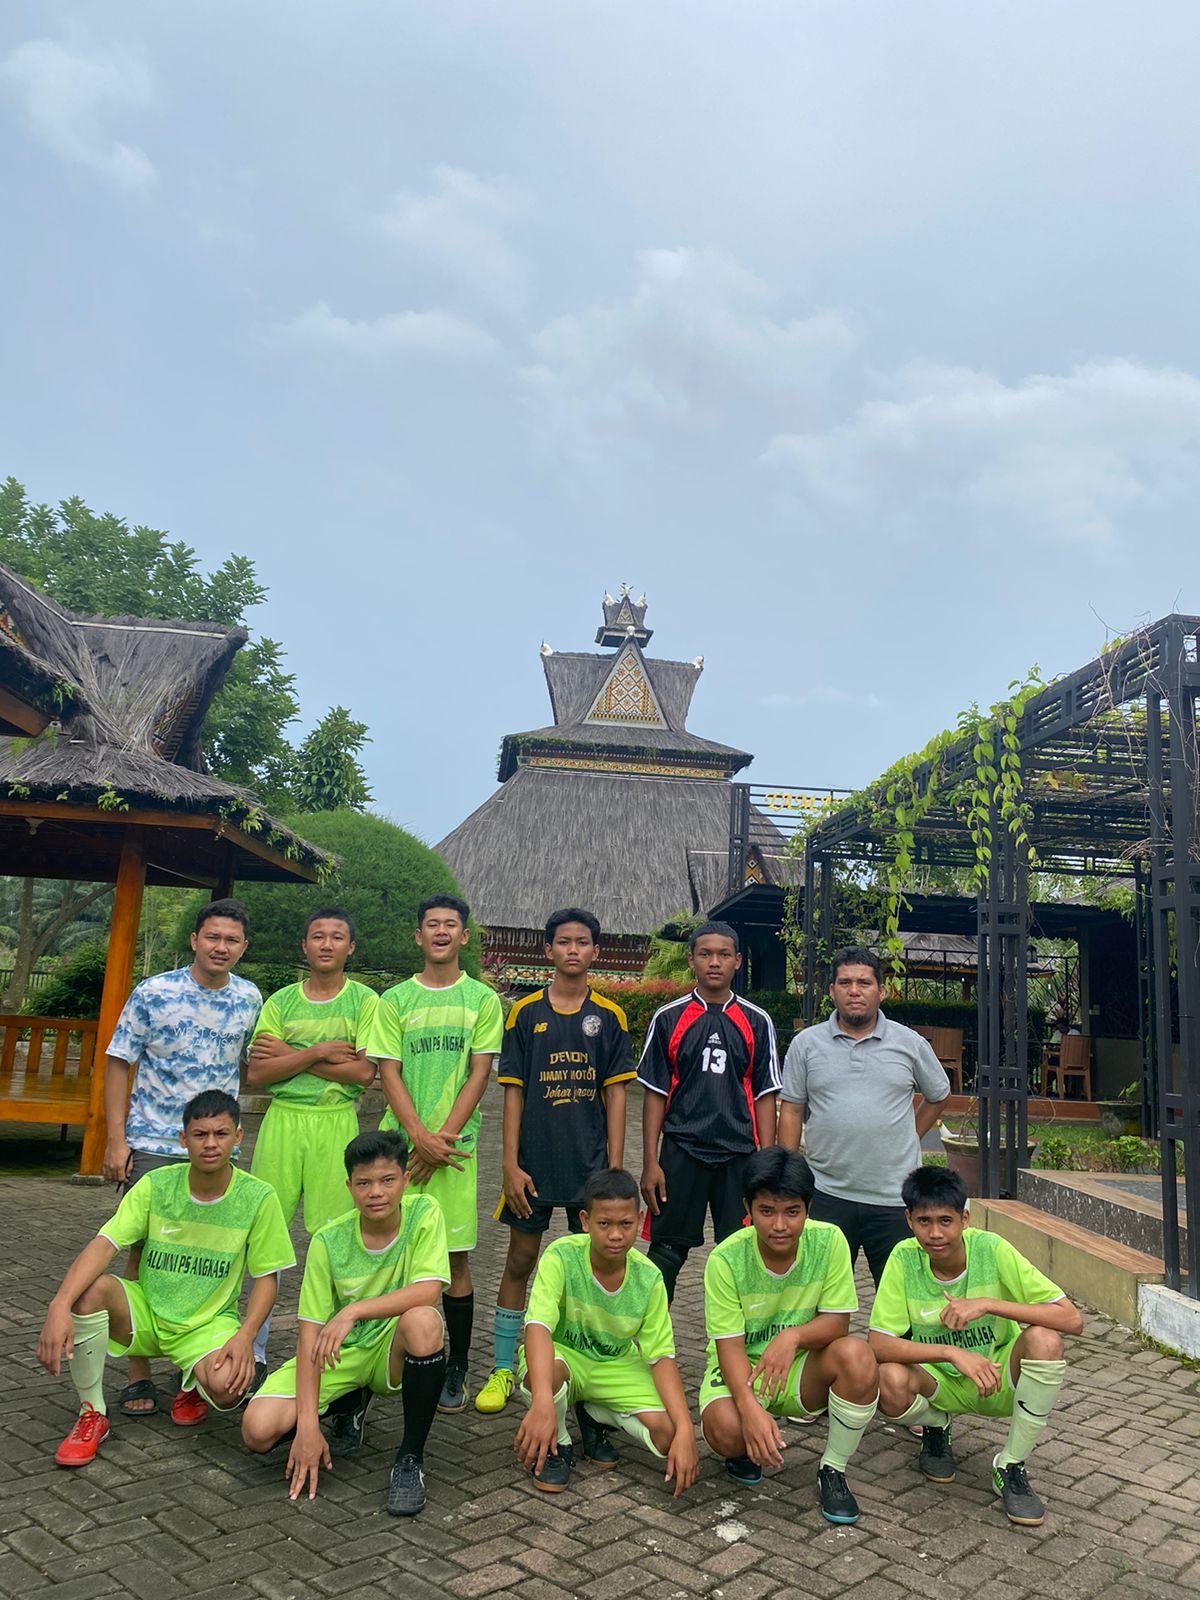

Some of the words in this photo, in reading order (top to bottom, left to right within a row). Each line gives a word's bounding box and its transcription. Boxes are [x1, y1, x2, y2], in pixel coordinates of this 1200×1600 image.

[702, 1047, 727, 1074] 13
[539, 1070, 568, 1082] JIMMY
[147, 1249, 179, 1273] ALUMNI
[190, 1257, 231, 1279] ANGKASA
